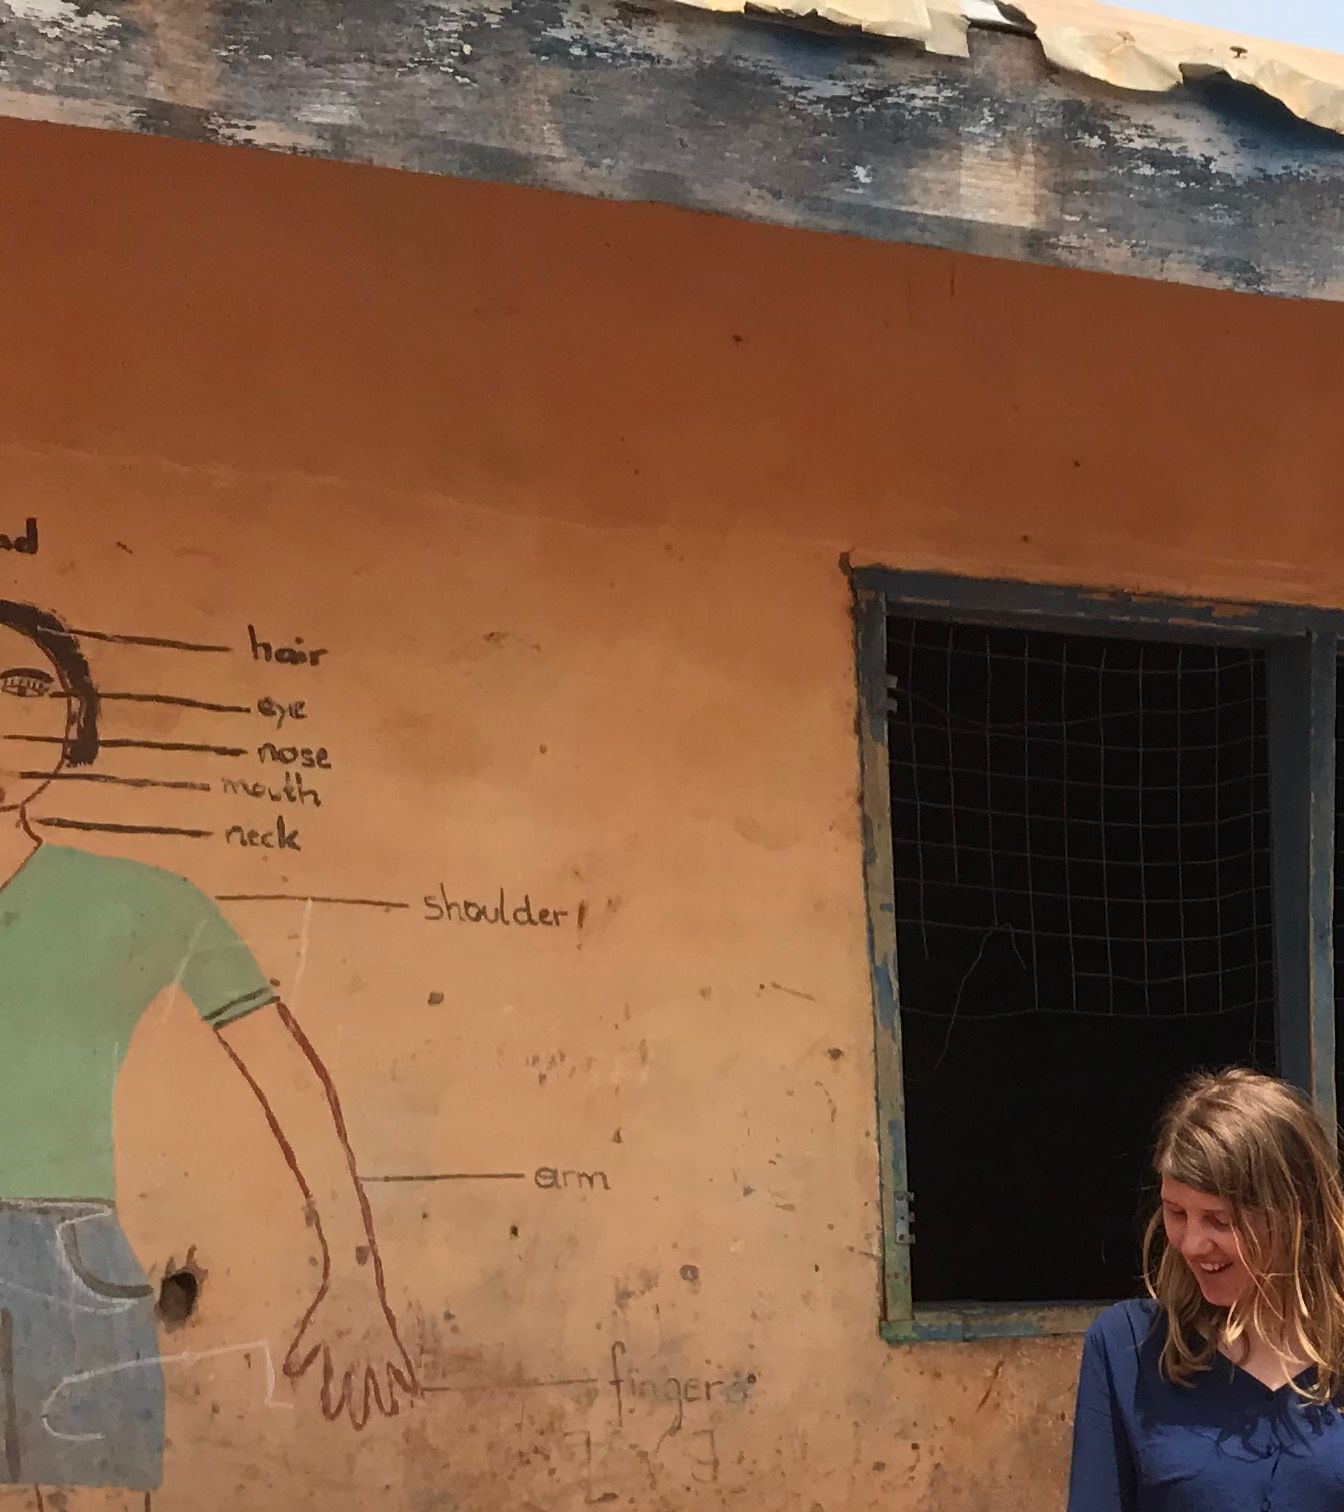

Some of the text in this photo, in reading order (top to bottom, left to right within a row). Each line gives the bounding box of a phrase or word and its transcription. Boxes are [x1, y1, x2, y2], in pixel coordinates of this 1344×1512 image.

[247, 624, 329, 667] hair
[257, 696, 308, 729] eye
[257, 742, 332, 769] nose
[225, 815, 301, 851] neck
[423, 882, 568, 927] shoulder
[533, 1165, 610, 1192] arm
